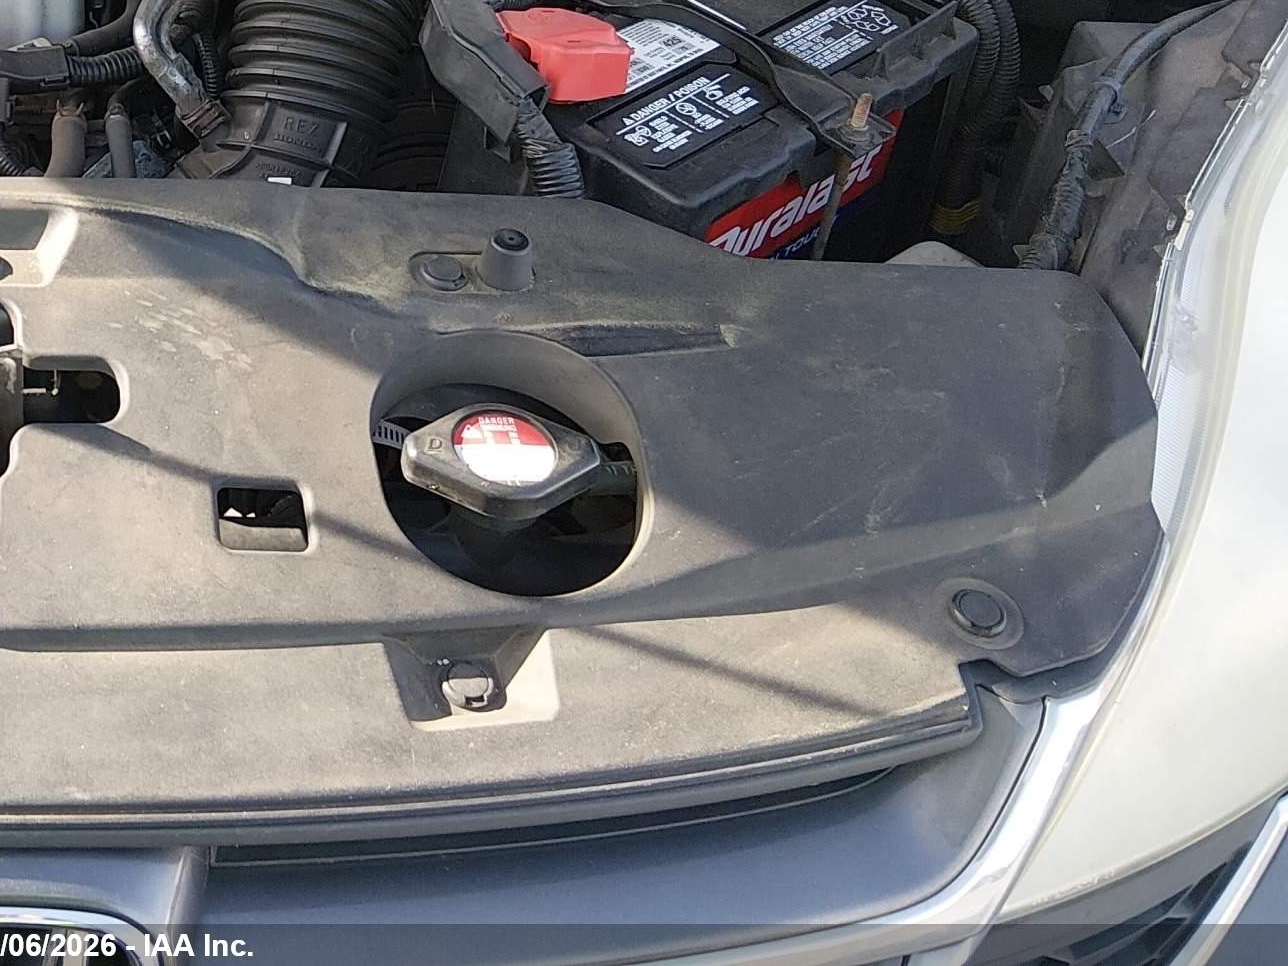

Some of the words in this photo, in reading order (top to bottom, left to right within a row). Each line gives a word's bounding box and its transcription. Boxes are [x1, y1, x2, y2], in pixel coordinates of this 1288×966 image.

[628, 96, 670, 122] DANGER
[674, 76, 712, 99] POISON
[477, 416, 515, 425] DANGER
